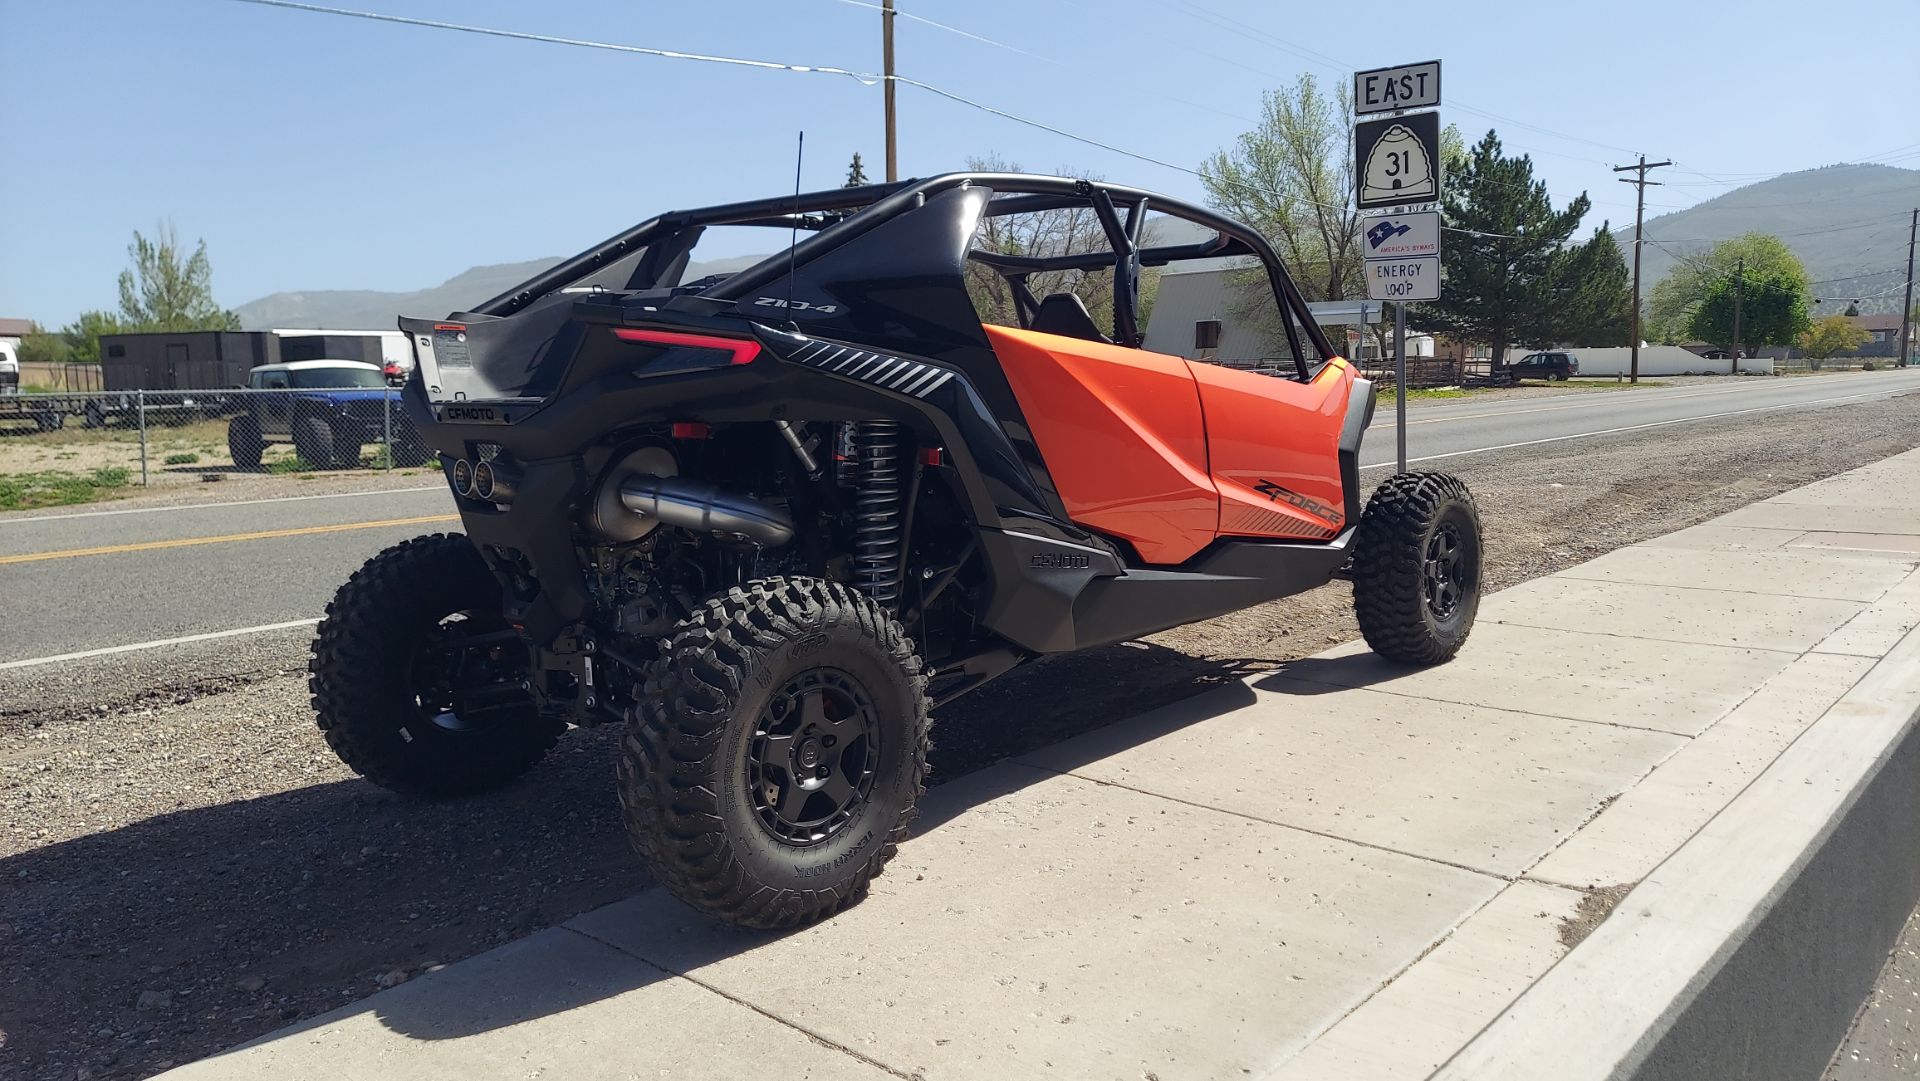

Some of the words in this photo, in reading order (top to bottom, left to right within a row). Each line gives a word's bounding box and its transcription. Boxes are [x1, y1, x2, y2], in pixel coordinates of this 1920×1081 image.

[1366, 73, 1428, 105] EAST
[1385, 151, 1409, 176] 31
[1377, 264, 1422, 278] ENERGY
[1385, 283, 1413, 296] LOOP
[448, 408, 494, 420] CFMOTO
[1031, 553, 1090, 568] CFMOTO
